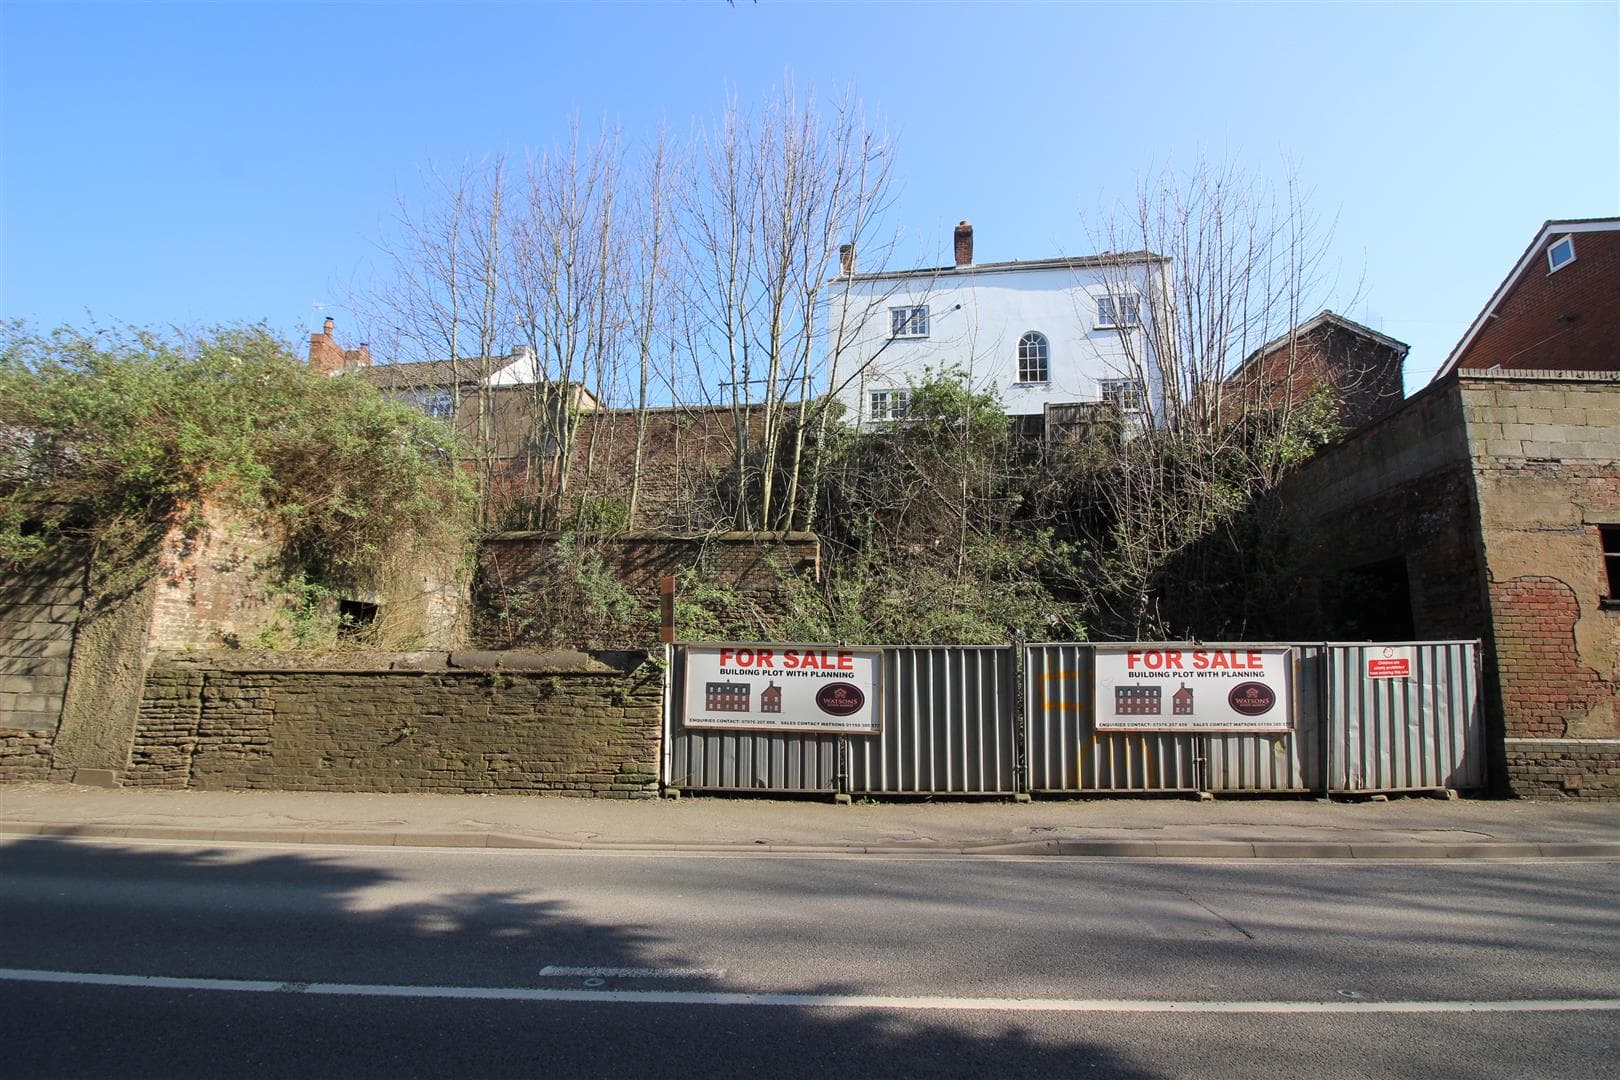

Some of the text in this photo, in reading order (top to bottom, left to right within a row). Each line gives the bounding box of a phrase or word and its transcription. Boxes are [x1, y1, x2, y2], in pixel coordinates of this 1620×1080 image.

[719, 648, 854, 670] FOR SALE
[1127, 649, 1264, 669] FOR SALE
[719, 668, 855, 679] BUILDING PLOT WITH PLANNING
[823, 697, 858, 705] WATSONS
[1234, 697, 1270, 705] WATSONS
